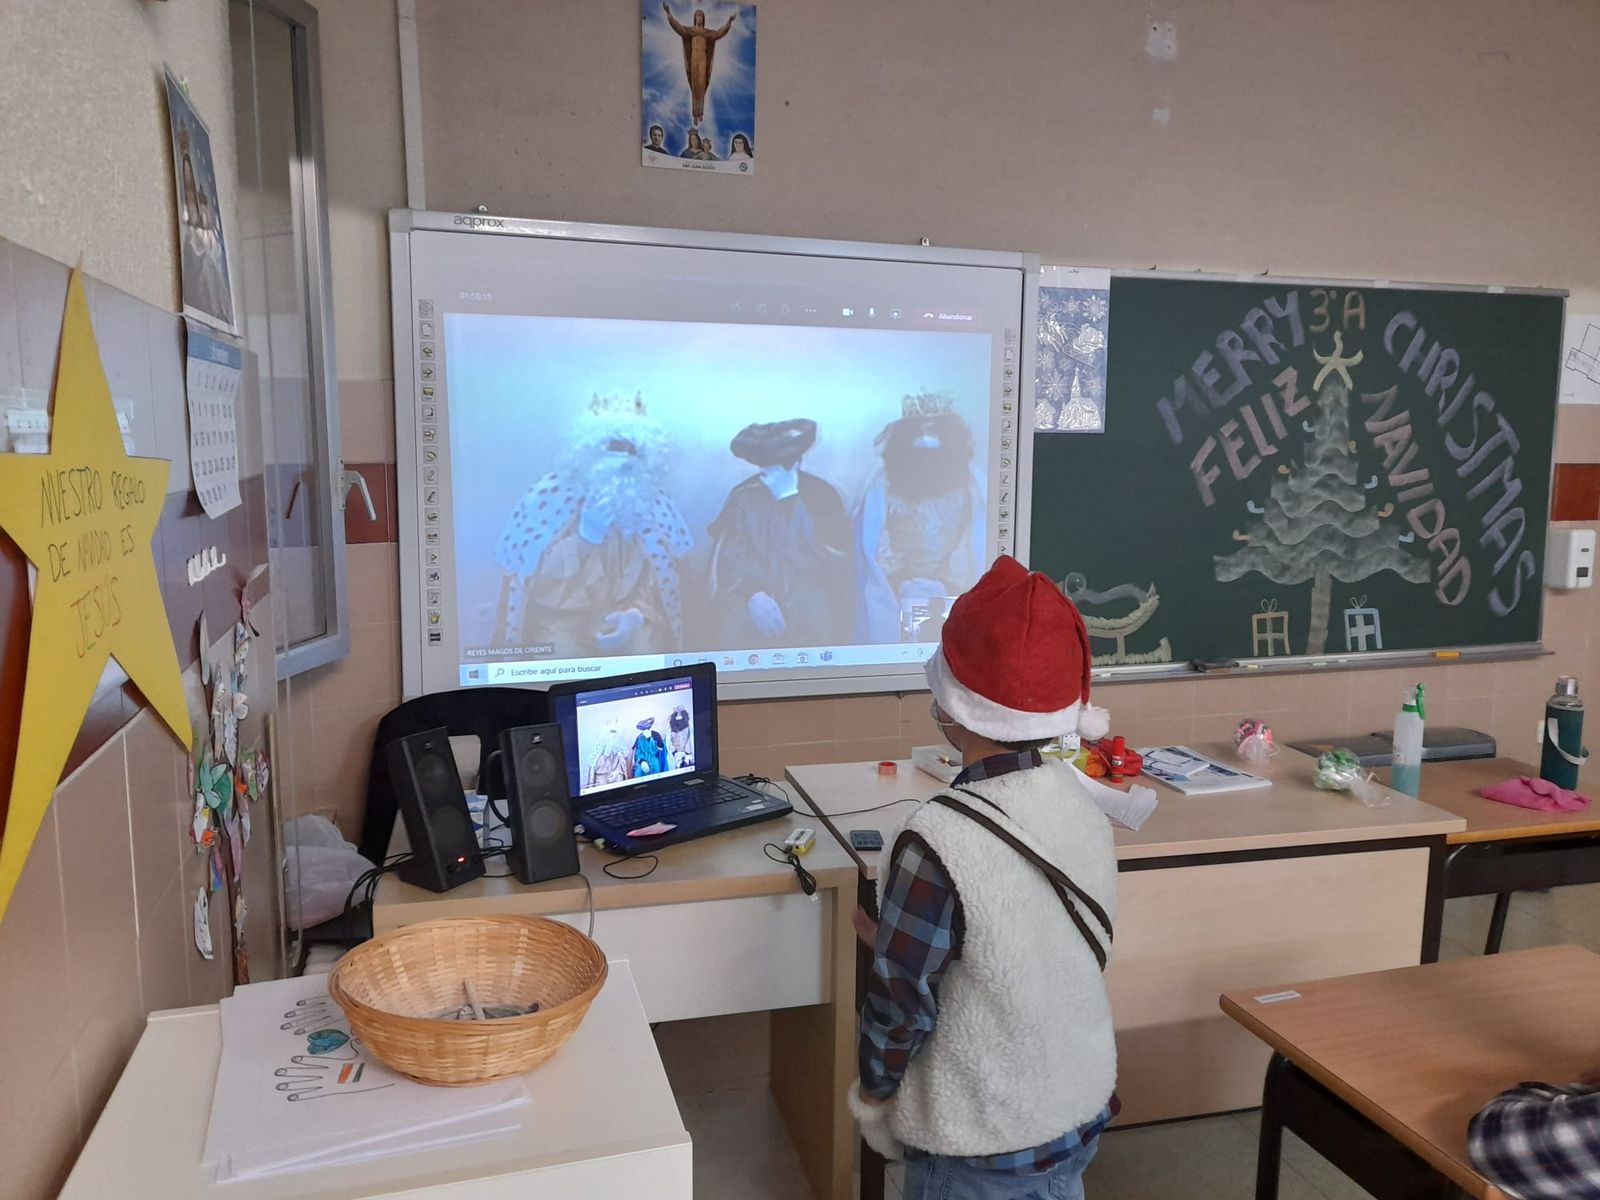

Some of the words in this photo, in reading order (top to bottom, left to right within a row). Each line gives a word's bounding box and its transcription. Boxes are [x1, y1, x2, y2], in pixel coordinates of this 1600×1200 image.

[1156, 291, 1305, 444] MERRY
[1384, 311, 1537, 617] CHRISTMAS
[1190, 366, 1310, 507] FELIZ
[1360, 385, 1473, 607] NAVIDAD
[47, 542, 71, 583] DE
[121, 524, 135, 557] ES
[70, 575, 122, 659] JESUS
[467, 648, 487, 656] REYES
[488, 647, 513, 655] MAGOS
[524, 645, 552, 653] ORIENTE
[511, 668, 538, 676] Escribe
[540, 667, 557, 675] aquí
[558, 666, 576, 674] para
[577, 665, 601, 673] buscar
